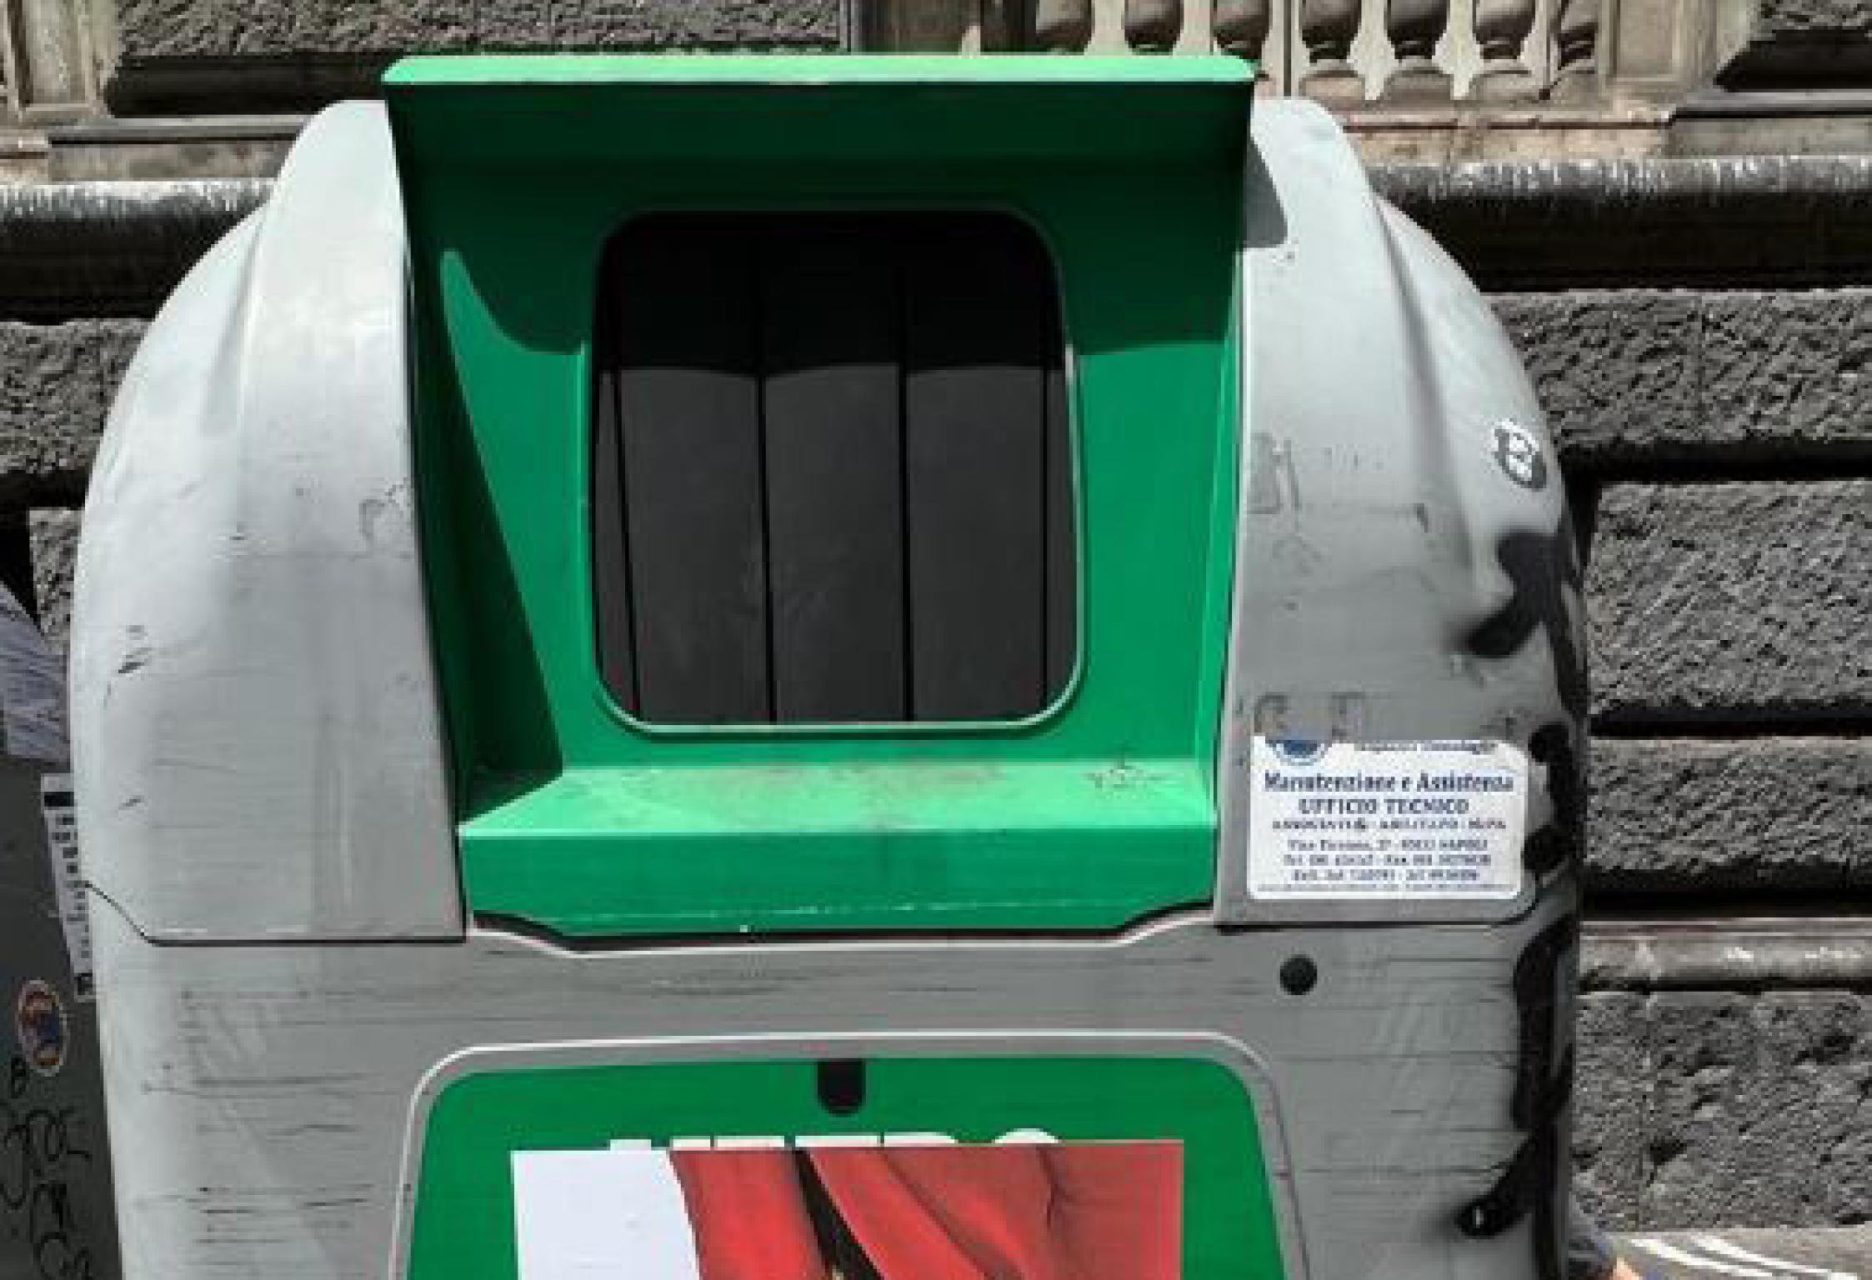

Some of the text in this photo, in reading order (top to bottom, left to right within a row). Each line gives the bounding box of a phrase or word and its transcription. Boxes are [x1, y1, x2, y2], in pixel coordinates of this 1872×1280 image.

[1264, 772, 1398, 793] Manutenzione
[1401, 777, 1412, 793] e
[1299, 798, 1469, 814] UFFICIO TECNICO
